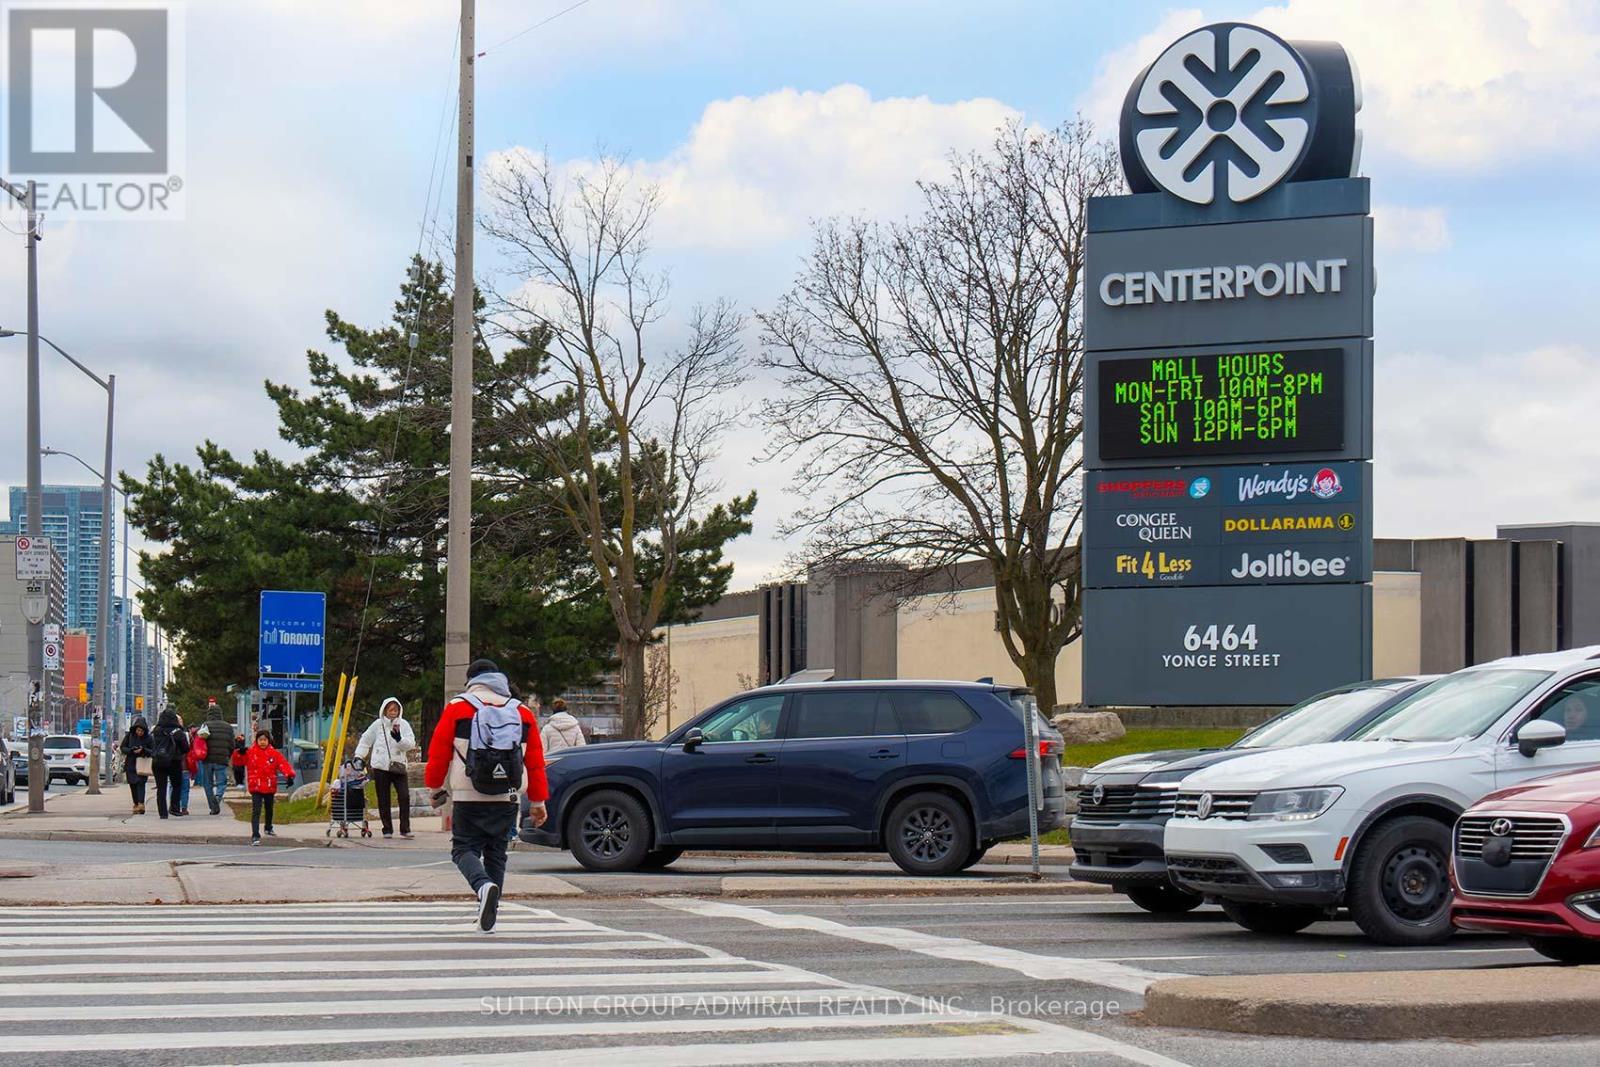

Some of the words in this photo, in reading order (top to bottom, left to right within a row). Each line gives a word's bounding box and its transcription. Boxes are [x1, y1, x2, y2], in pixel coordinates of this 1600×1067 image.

[1099, 258, 1348, 306] CENTERPOINT
[1152, 358, 1203, 381] MALL
[1218, 353, 1284, 378] HOURS
[1115, 379, 1204, 404] MON-FRI
[1218, 372, 1323, 399] 10AM-8PM
[1140, 401, 1178, 423] SAT
[1193, 395, 1297, 421] 10AM-6PM
[1140, 421, 1178, 444] SUN
[1193, 417, 1297, 442] 12PM-6PM
[1238, 469, 1309, 502] Wendy's
[1116, 512, 1178, 527] CONGEE
[1224, 515, 1335, 532] DOLLARAMA
[1138, 526, 1193, 543] QUEEN
[1116, 554, 1138, 574] Fit
[1141, 551, 1155, 580] 4
[1158, 552, 1192, 573] Less
[279, 630, 320, 645] TORONTO
[1183, 624, 1258, 651] 6464
[1162, 654, 1217, 667] YONGE
[1224, 653, 1281, 667] STREET
